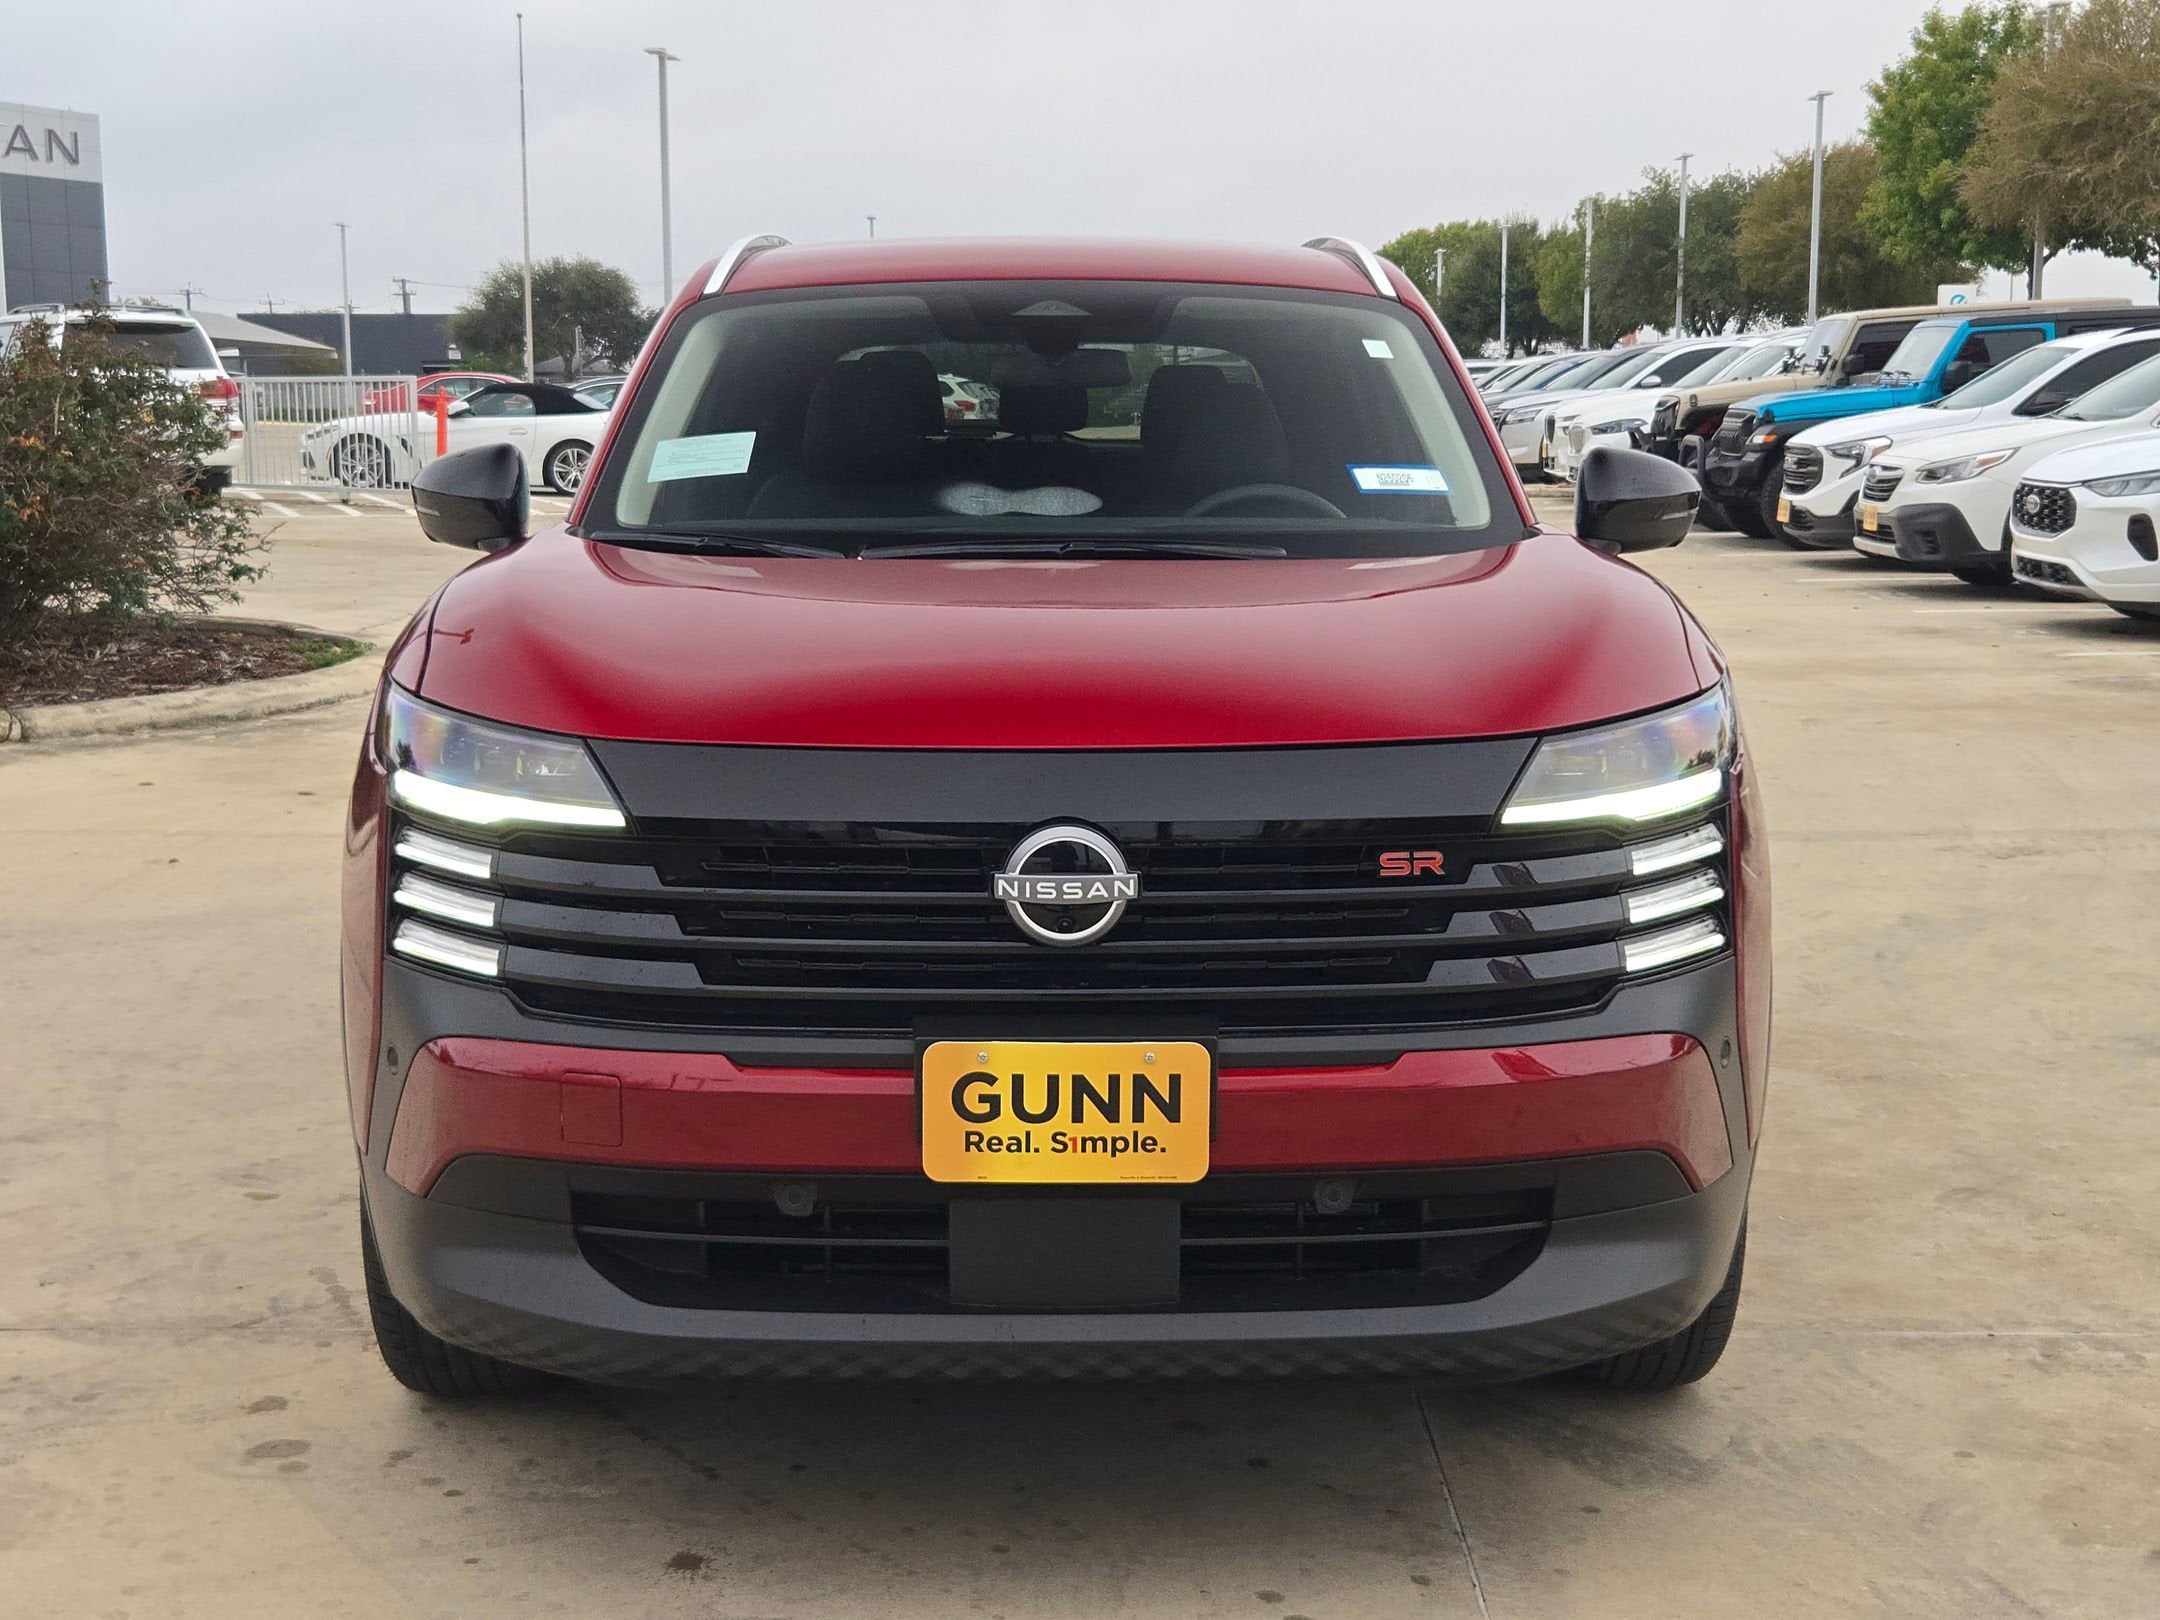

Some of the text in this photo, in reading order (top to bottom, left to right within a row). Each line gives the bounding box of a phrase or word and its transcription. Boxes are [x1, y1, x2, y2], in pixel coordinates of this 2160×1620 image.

[1379, 850, 1446, 876] SR
[997, 878, 1135, 900] NISSAN
[950, 1070, 1183, 1125] GUNN
[964, 1130, 1168, 1159] Real. S1mple.
